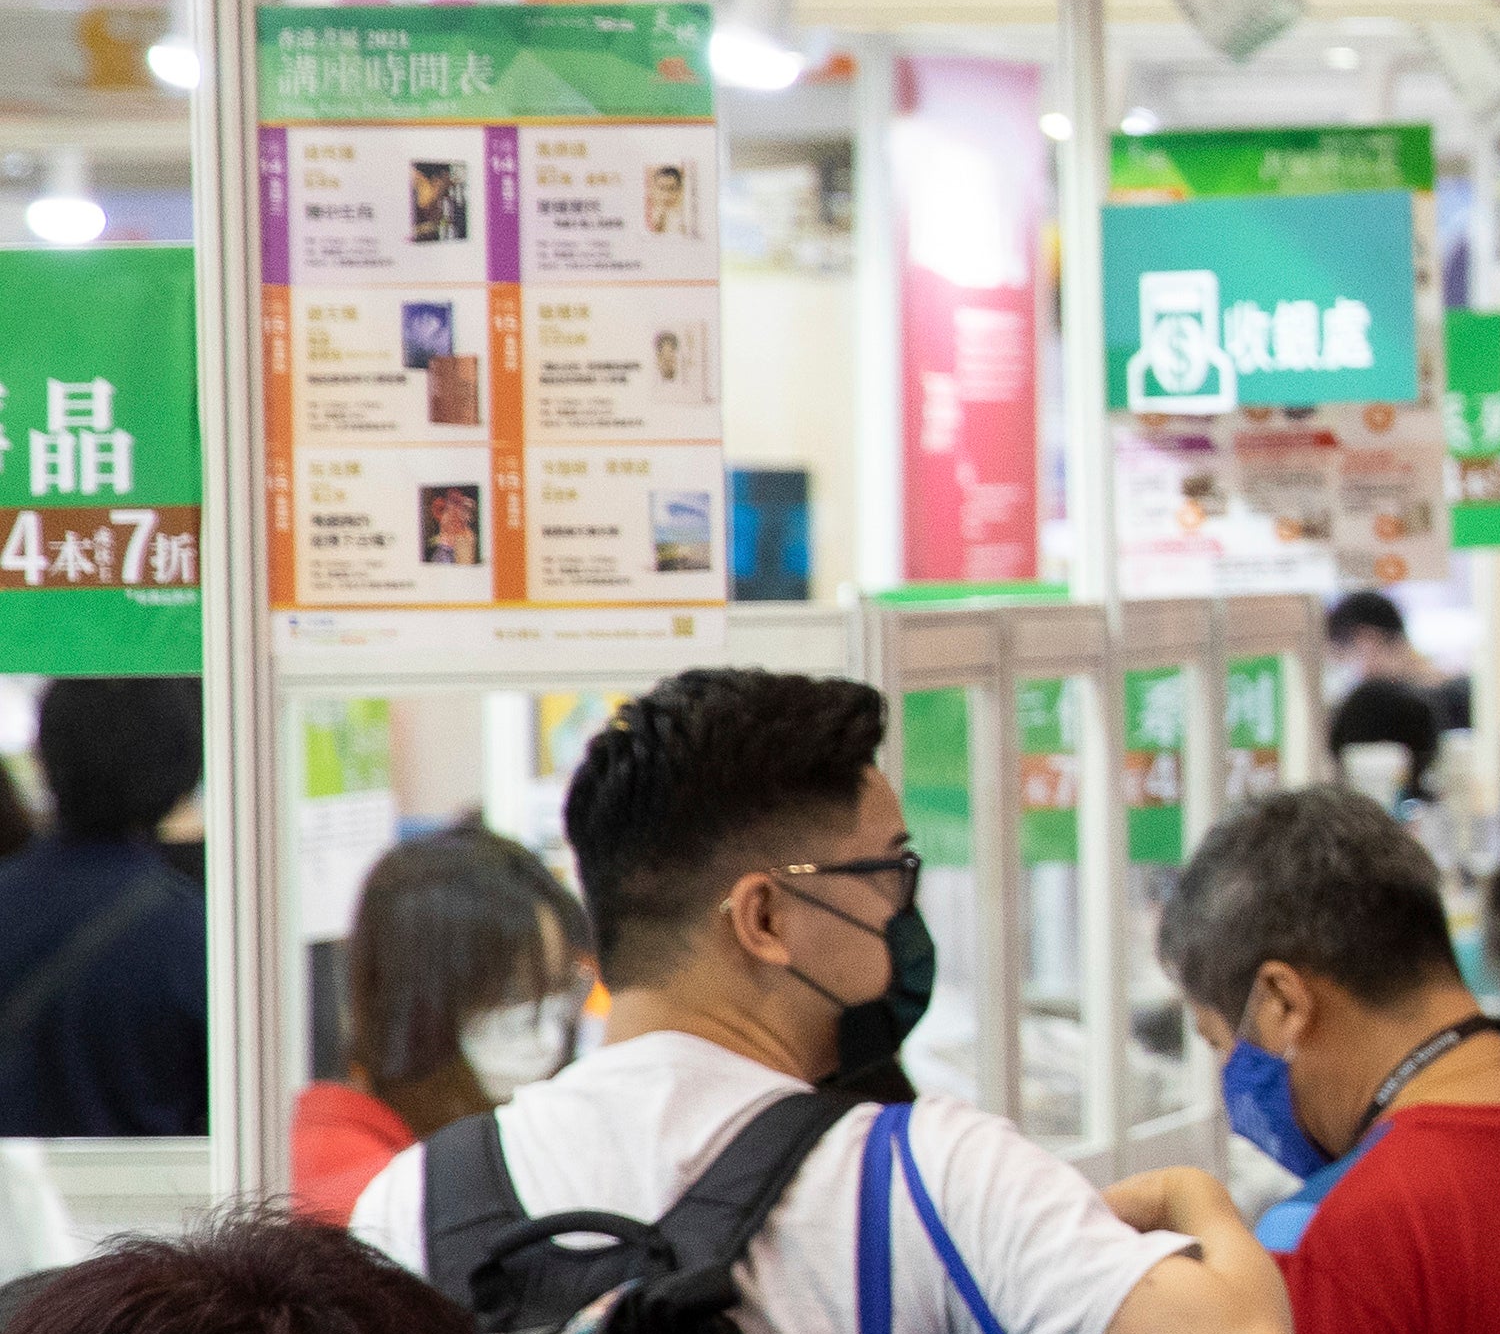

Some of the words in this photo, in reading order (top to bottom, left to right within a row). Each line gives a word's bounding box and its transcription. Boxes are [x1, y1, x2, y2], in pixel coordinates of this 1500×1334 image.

[278, 49, 495, 97] 講座時間表
